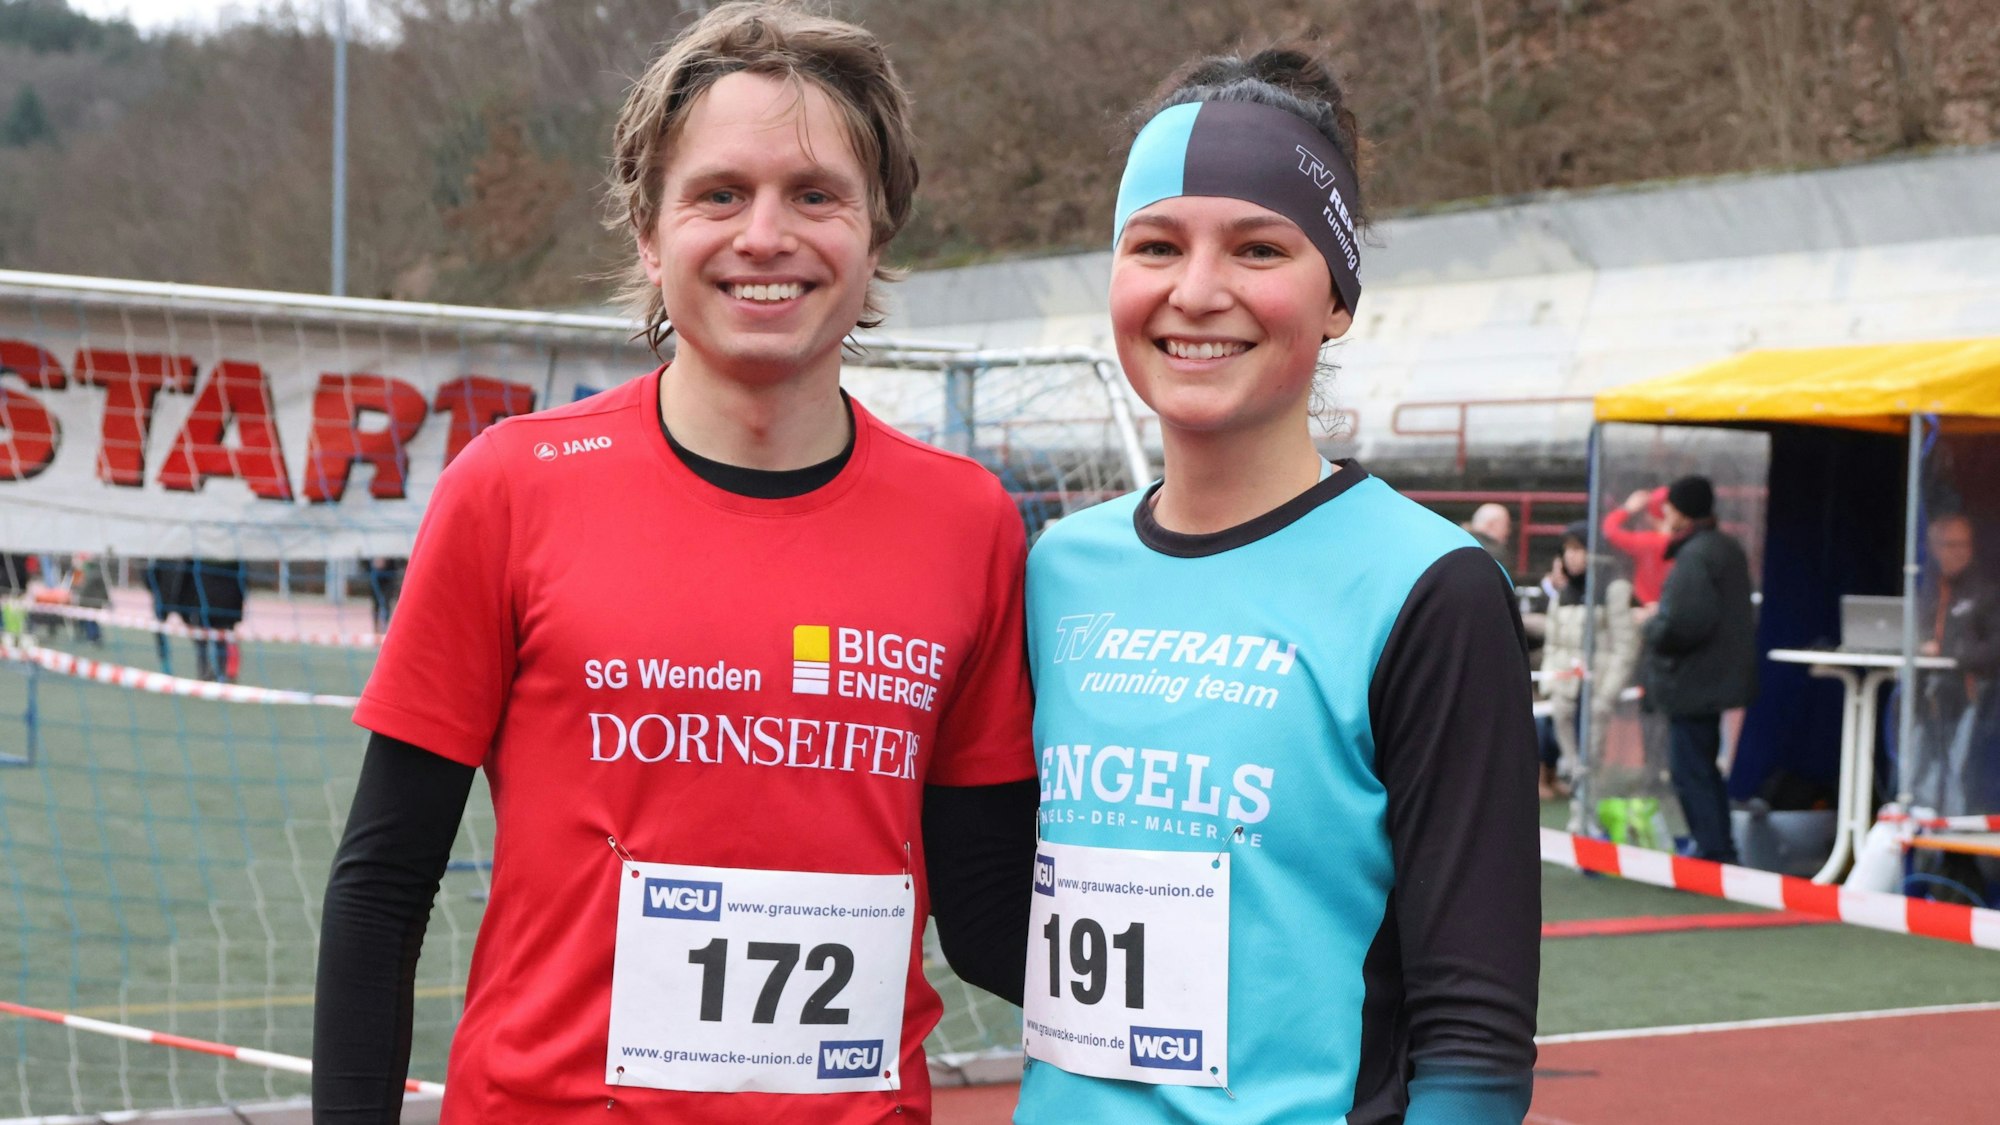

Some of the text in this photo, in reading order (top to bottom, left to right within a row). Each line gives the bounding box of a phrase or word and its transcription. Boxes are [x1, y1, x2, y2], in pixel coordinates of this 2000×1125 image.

[1296, 144, 1336, 190] TV
[1323, 205, 1358, 271] running
[0, 339, 536, 502] START
[562, 436, 613, 456] JAKO
[838, 626, 946, 680] BIGGE
[1095, 628, 1298, 676] REFRATH
[584, 658, 761, 691] SG Wenden
[838, 670, 938, 712] ENERGIE
[1080, 669, 1280, 710] running team
[1040, 743, 1275, 824] ENGELS
[649, 885, 905, 918] WGU www.grauwacke-union.de
[1057, 877, 1215, 898] www.grauwacke-union.de
[688, 937, 855, 1025] 172
[1043, 913, 1145, 1009] 191
[621, 1045, 880, 1071] www.grauwacke-union.de WGU
[1026, 1019, 1198, 1062] www.grauwacke-union.de WGU
